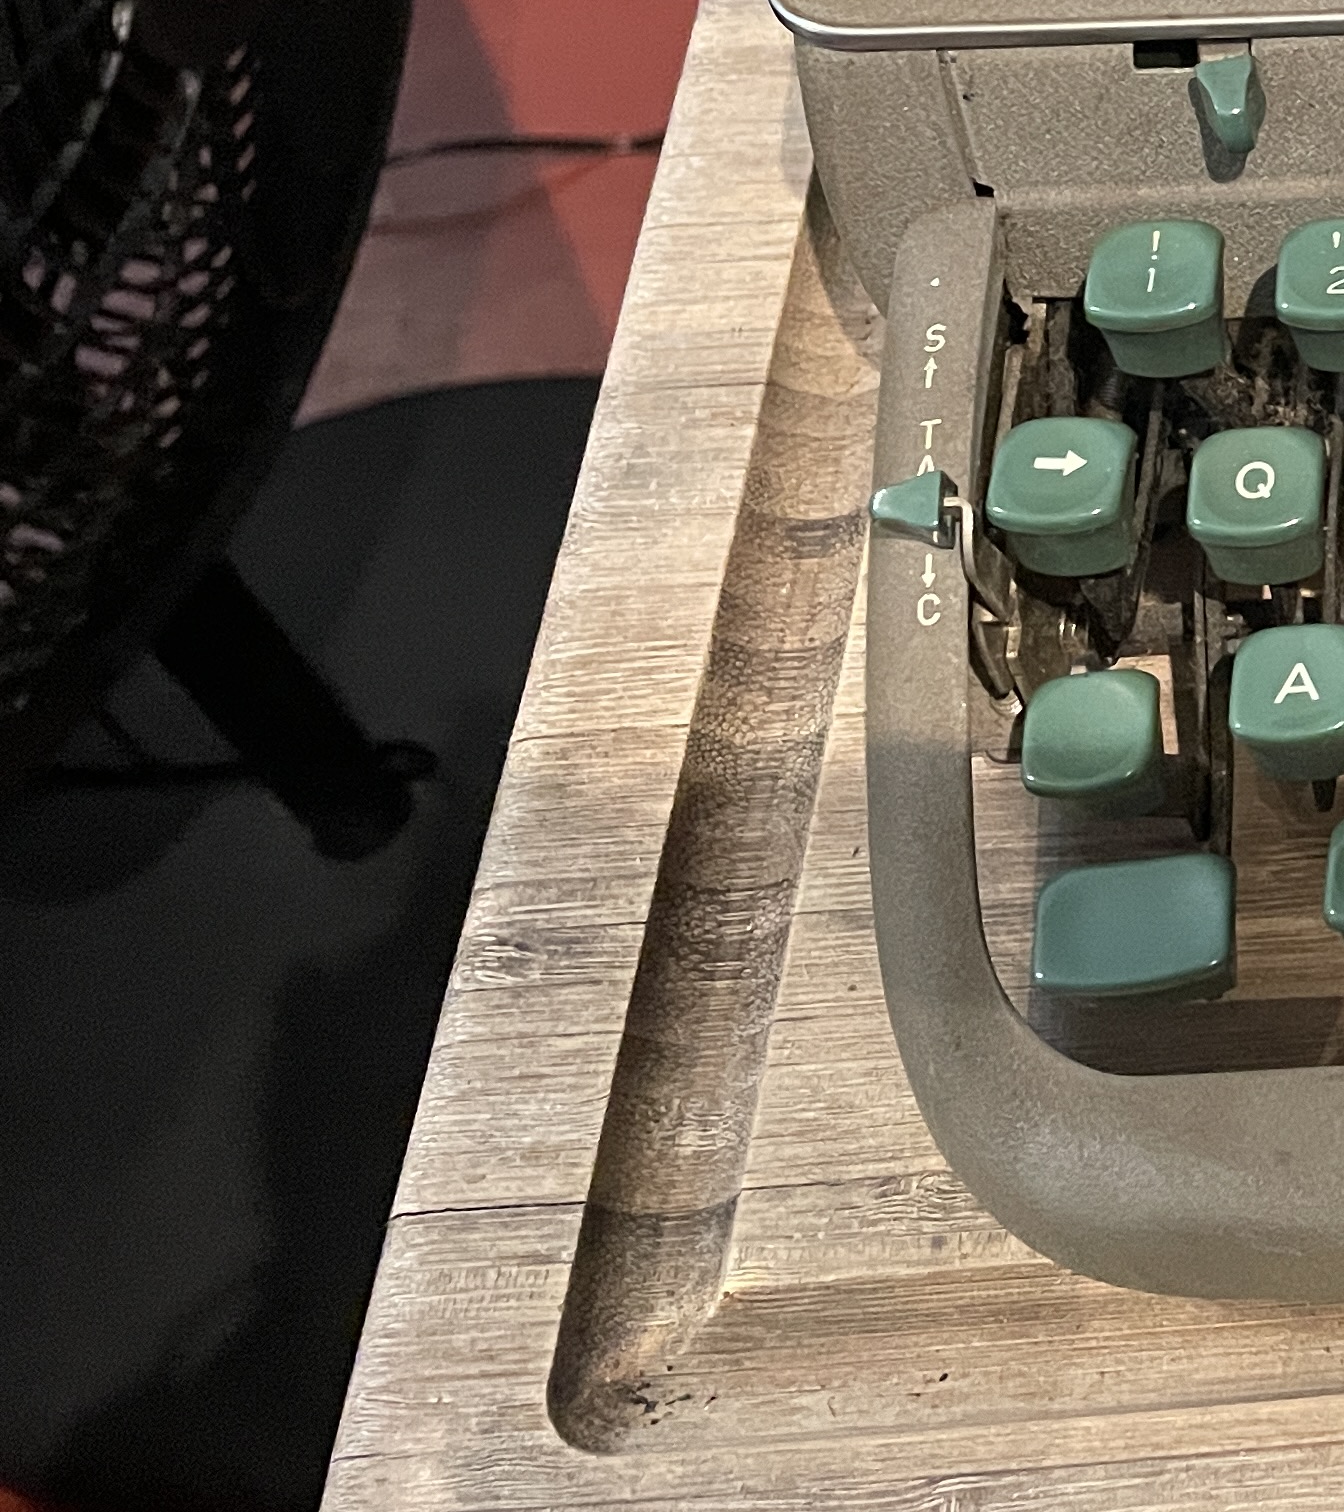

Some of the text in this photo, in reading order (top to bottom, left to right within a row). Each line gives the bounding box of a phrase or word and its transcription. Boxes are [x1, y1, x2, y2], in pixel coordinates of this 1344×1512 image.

[924, 323, 947, 353] S
[1234, 460, 1276, 501] Q
[916, 592, 942, 627] C
[1273, 661, 1320, 705] A
